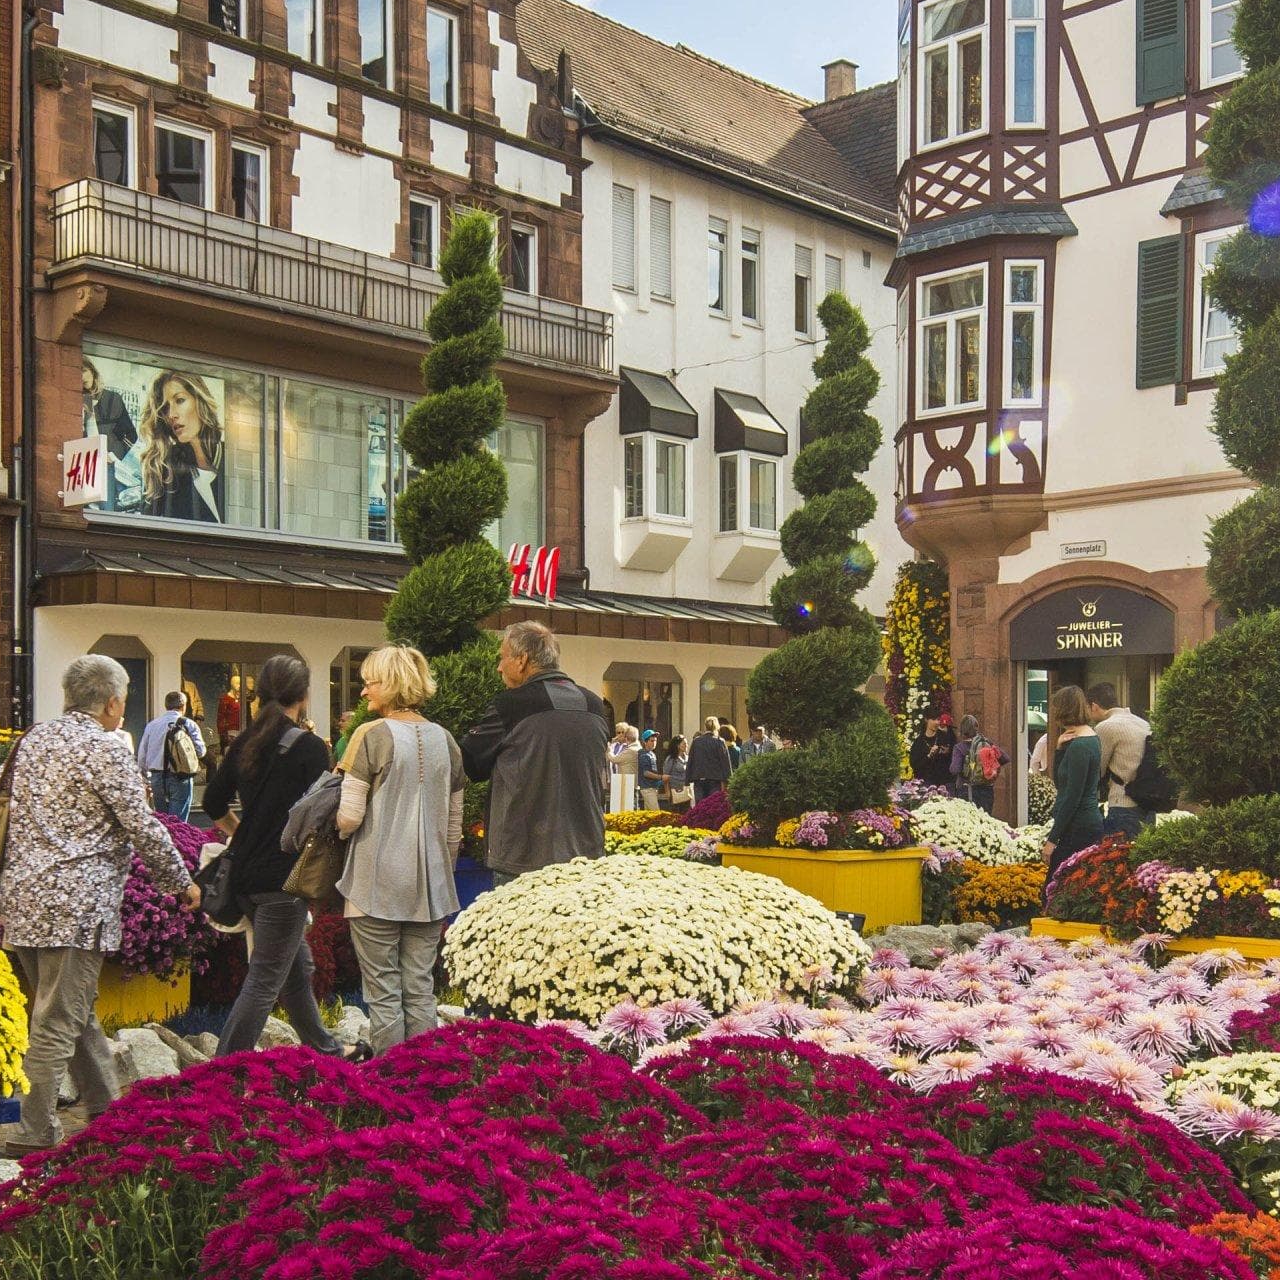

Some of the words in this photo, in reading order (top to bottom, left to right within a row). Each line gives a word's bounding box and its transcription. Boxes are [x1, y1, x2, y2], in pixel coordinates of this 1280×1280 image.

[66, 449, 98, 492] H&M
[1065, 544, 1101, 555] Sonnenplatz
[507, 543, 561, 602] H&M
[1068, 621, 1111, 631] JUWELIER
[1056, 632, 1123, 650] SPINNER
